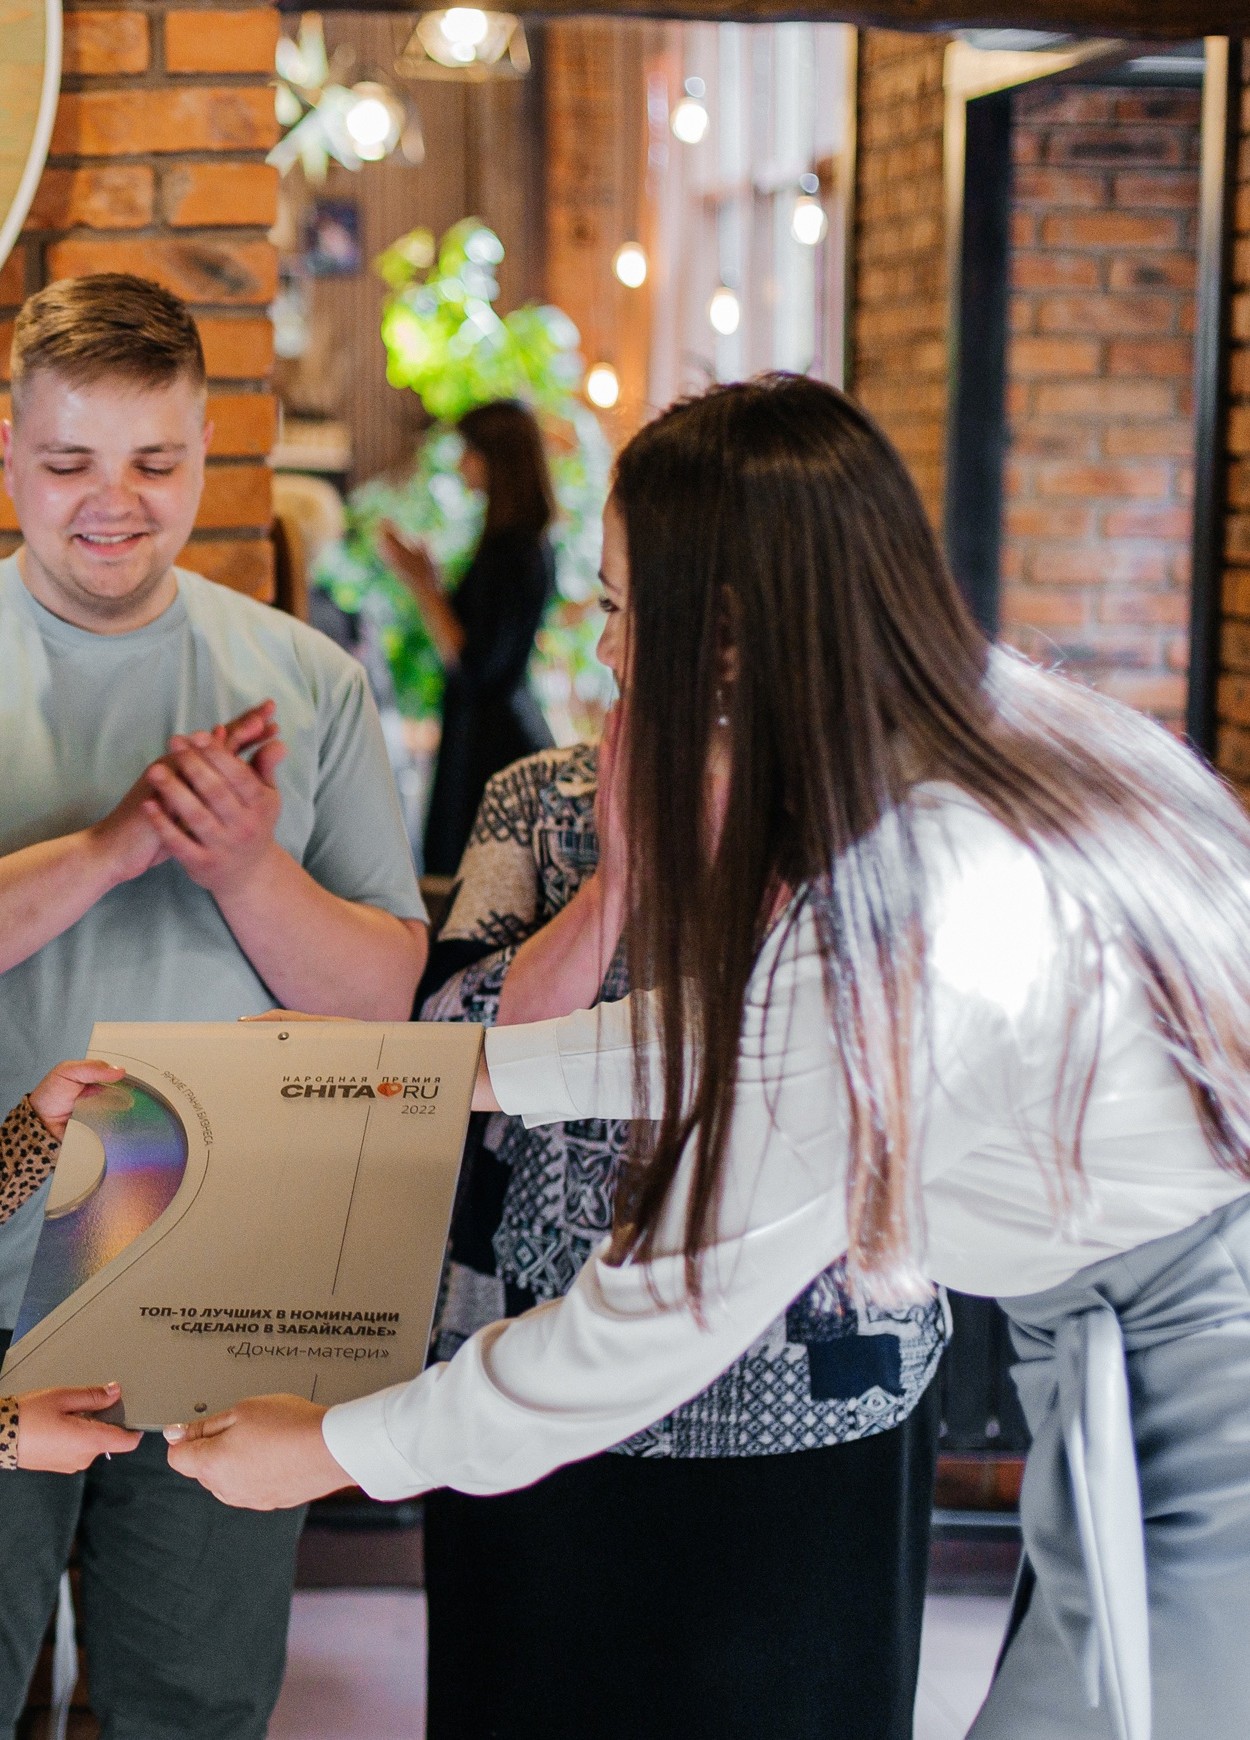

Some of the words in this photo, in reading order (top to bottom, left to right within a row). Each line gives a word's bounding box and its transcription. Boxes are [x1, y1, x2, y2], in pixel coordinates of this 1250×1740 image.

[161, 1070, 187, 1091] ЯРКИЕ
[182, 1088, 203, 1112] ГРАНИ
[197, 1111, 213, 1146] БИЗНЕСА
[401, 1105, 436, 1115] 2022
[139, 1307, 197, 1318] ТОП-10
[200, 1308, 272, 1319] ЛУЧШИХ
[276, 1310, 286, 1319] В
[290, 1310, 399, 1323] НОМИНАЦИИ
[170, 1322, 259, 1334] «СДЕЛАНО
[263, 1324, 274, 1334] В
[277, 1323, 397, 1337] ЗАБАЙКАЛЬЕ»
[226, 1342, 390, 1360] «Дочки-матери»
